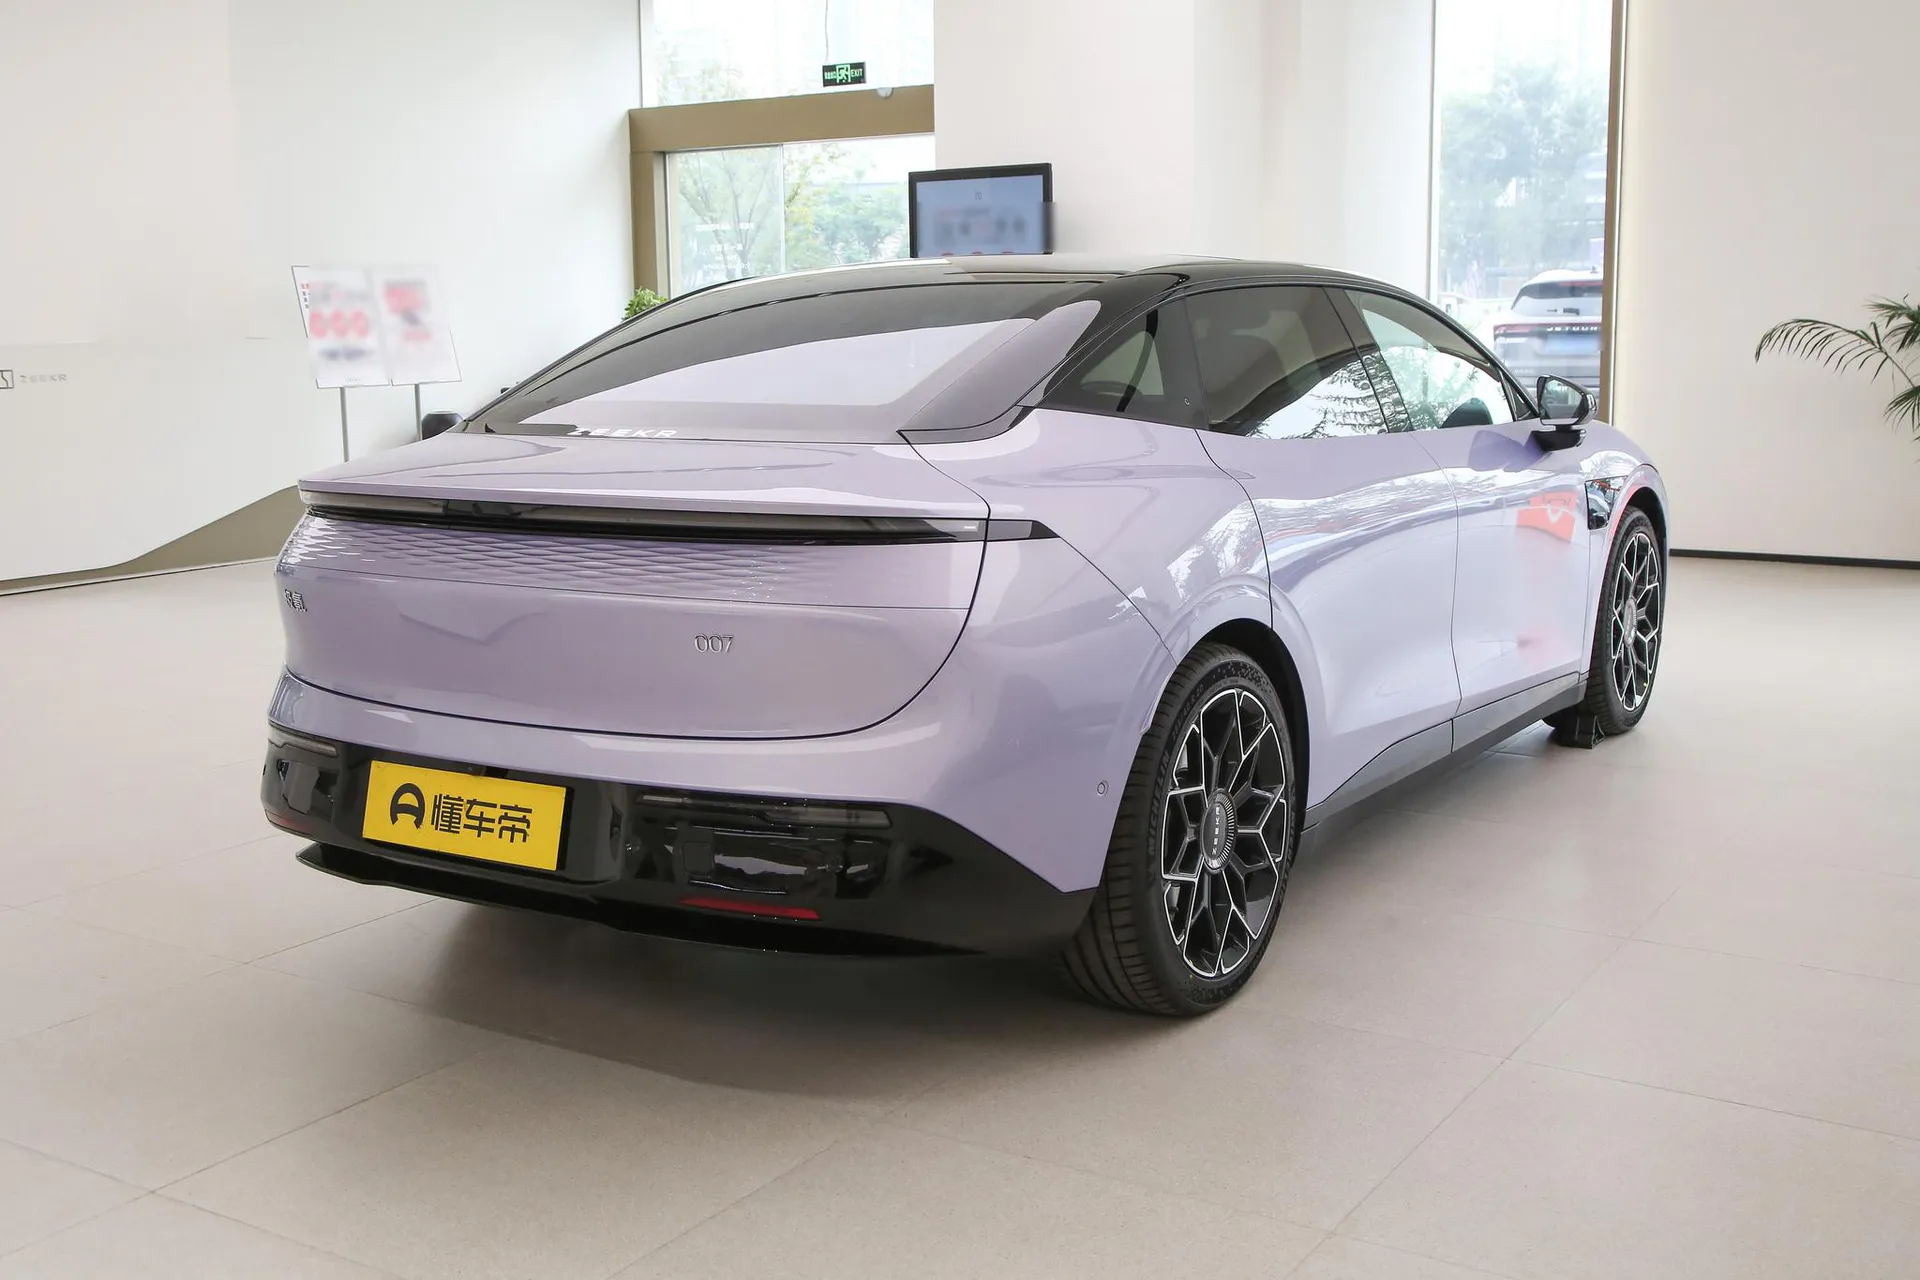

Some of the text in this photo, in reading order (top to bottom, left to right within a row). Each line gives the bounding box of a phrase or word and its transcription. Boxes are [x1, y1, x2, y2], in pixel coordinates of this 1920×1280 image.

[851, 68, 863, 77] EXIT
[567, 427, 677, 438] ZEEKR
[694, 633, 734, 653] 007
[431, 793, 533, 843] 懂车帝
[1148, 750, 1170, 856] MICHELIN
[1211, 806, 1220, 856] ZEEKR
